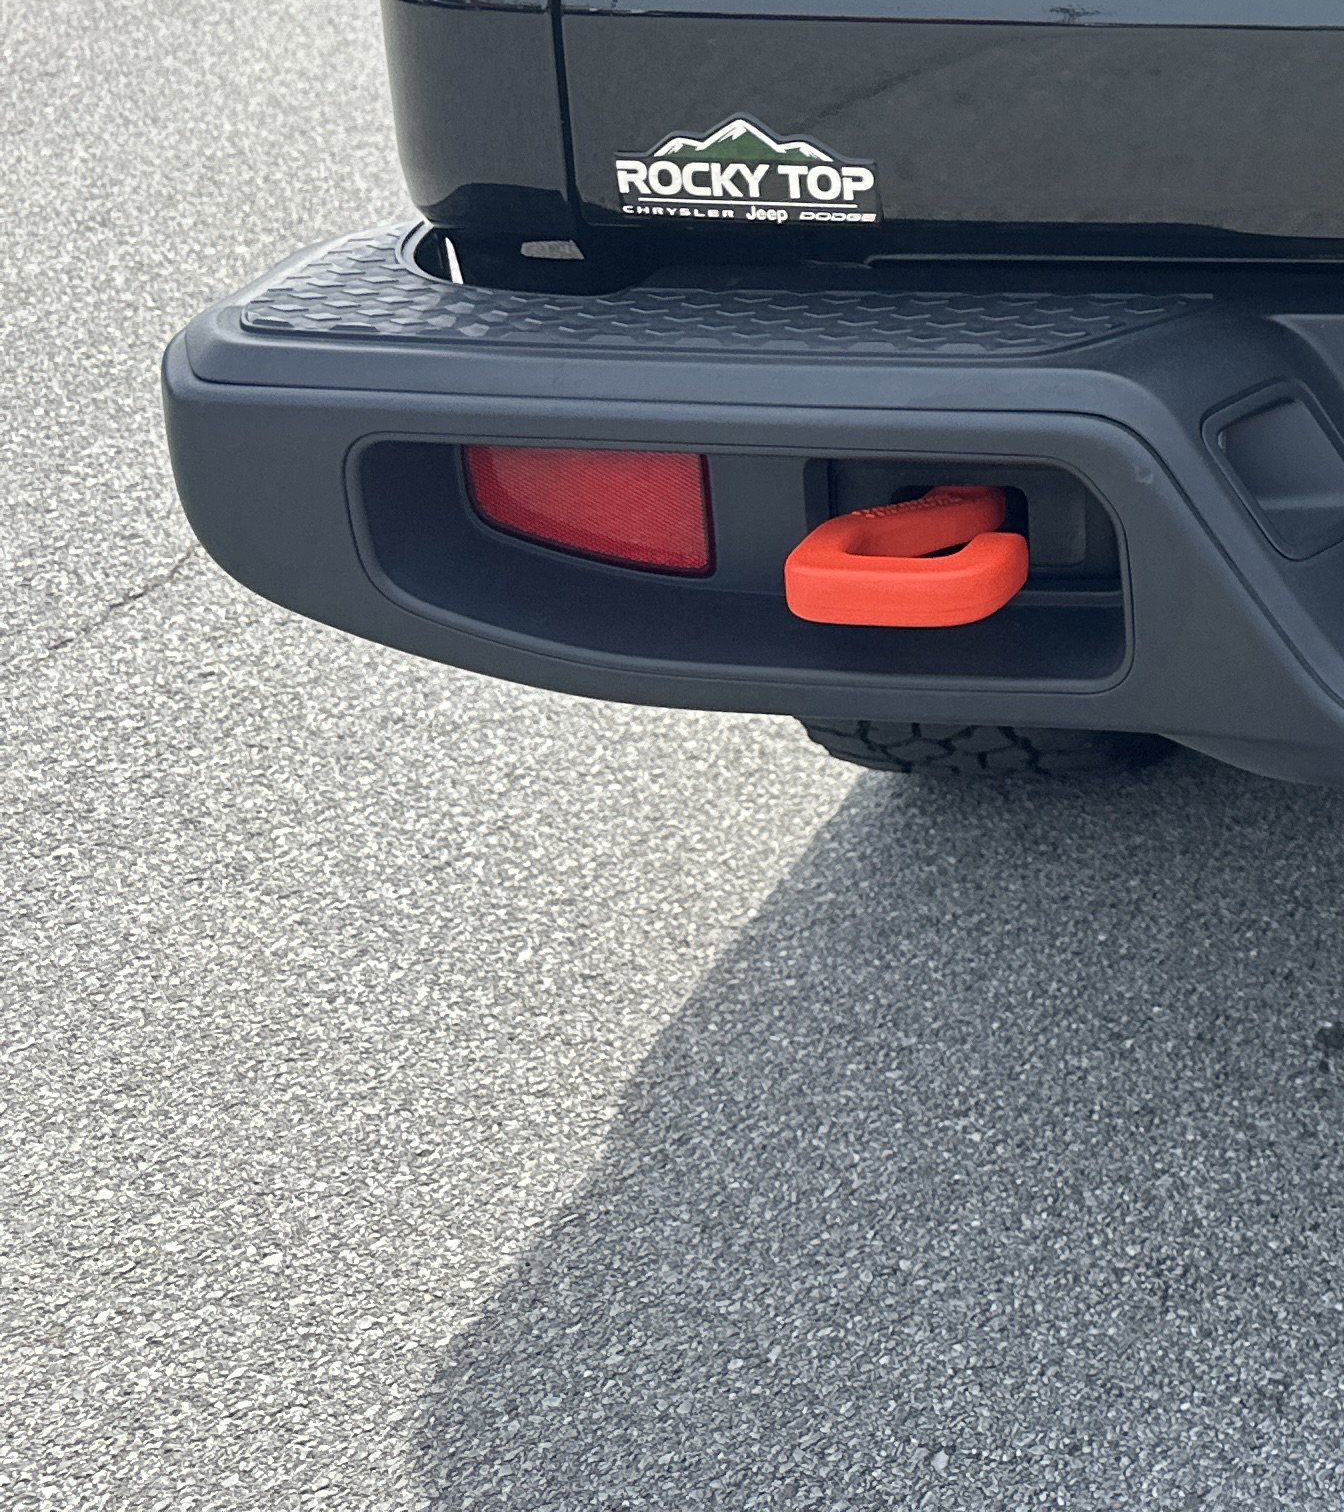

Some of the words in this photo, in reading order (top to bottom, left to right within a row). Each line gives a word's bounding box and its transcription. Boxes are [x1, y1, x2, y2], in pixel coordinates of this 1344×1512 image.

[615, 159, 770, 197] ROCKY
[777, 165, 875, 201] TOP
[622, 205, 735, 218] CHRYSLER
[746, 205, 789, 224] Jeep
[799, 212, 877, 223] DODGE
